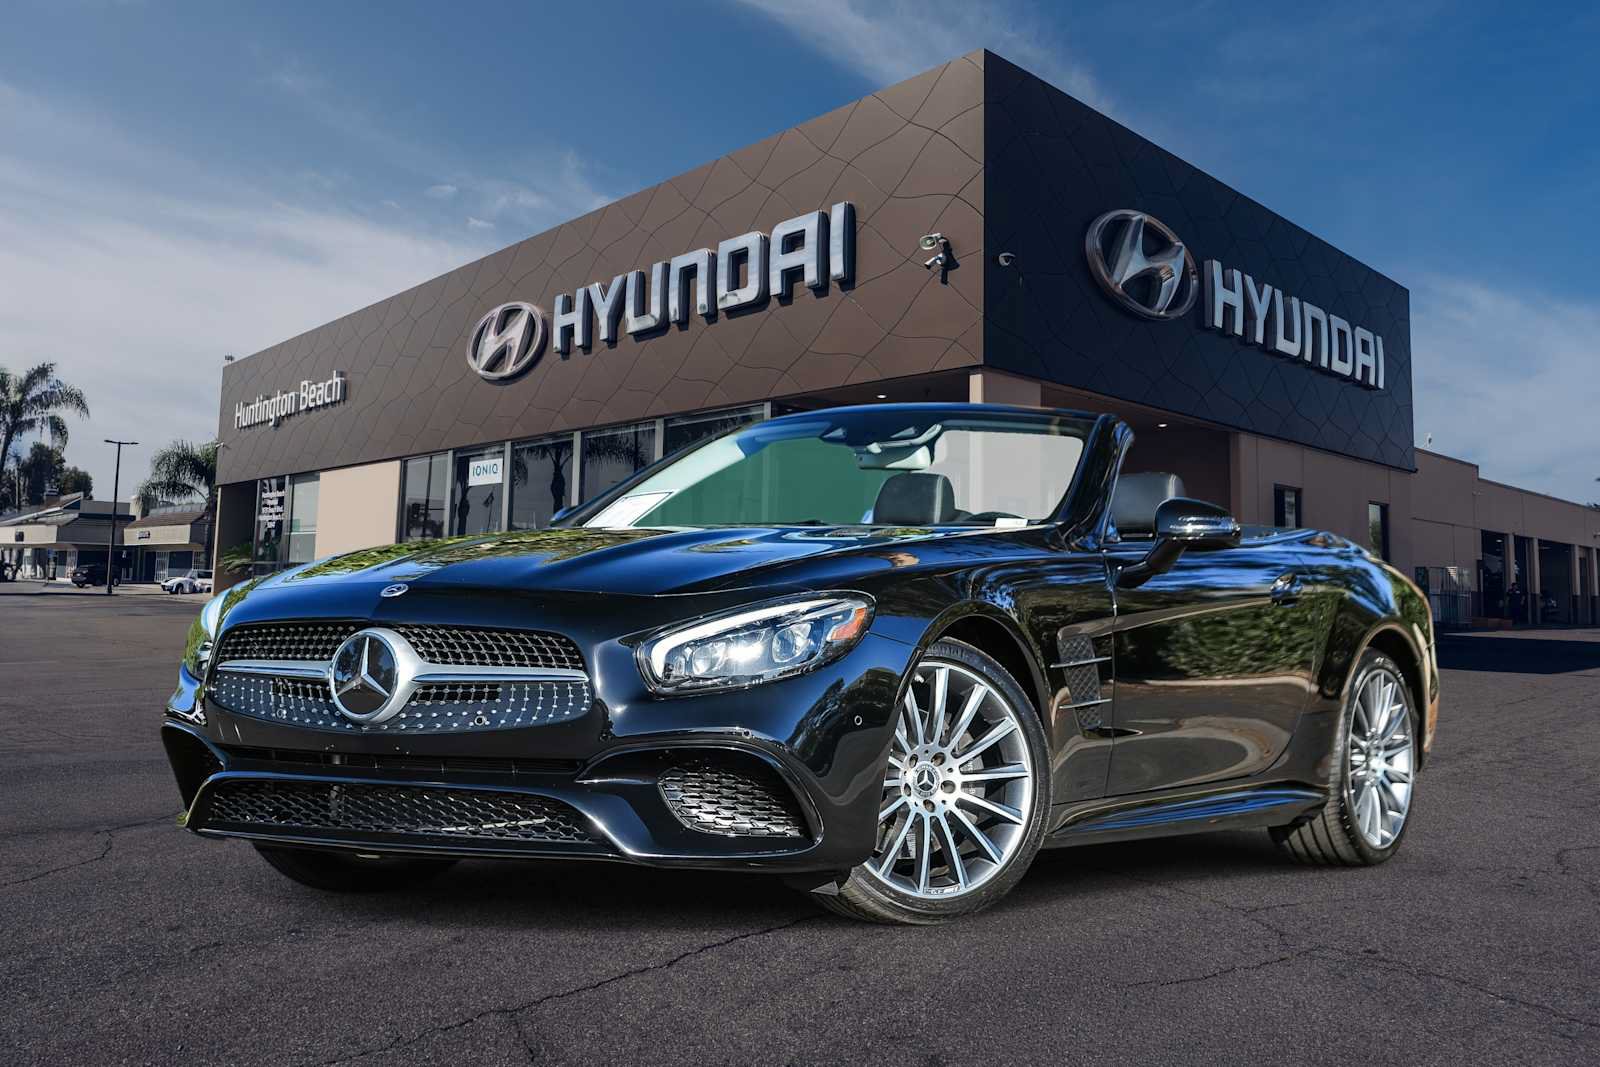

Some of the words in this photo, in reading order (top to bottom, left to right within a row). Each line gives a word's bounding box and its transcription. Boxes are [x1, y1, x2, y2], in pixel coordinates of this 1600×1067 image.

[553, 201, 853, 354] HYUNDAI
[1204, 259, 1385, 390] HYUNDAI
[234, 389, 298, 429] Huntington
[300, 370, 345, 410] Beach
[472, 463, 499, 477] IONIQ
